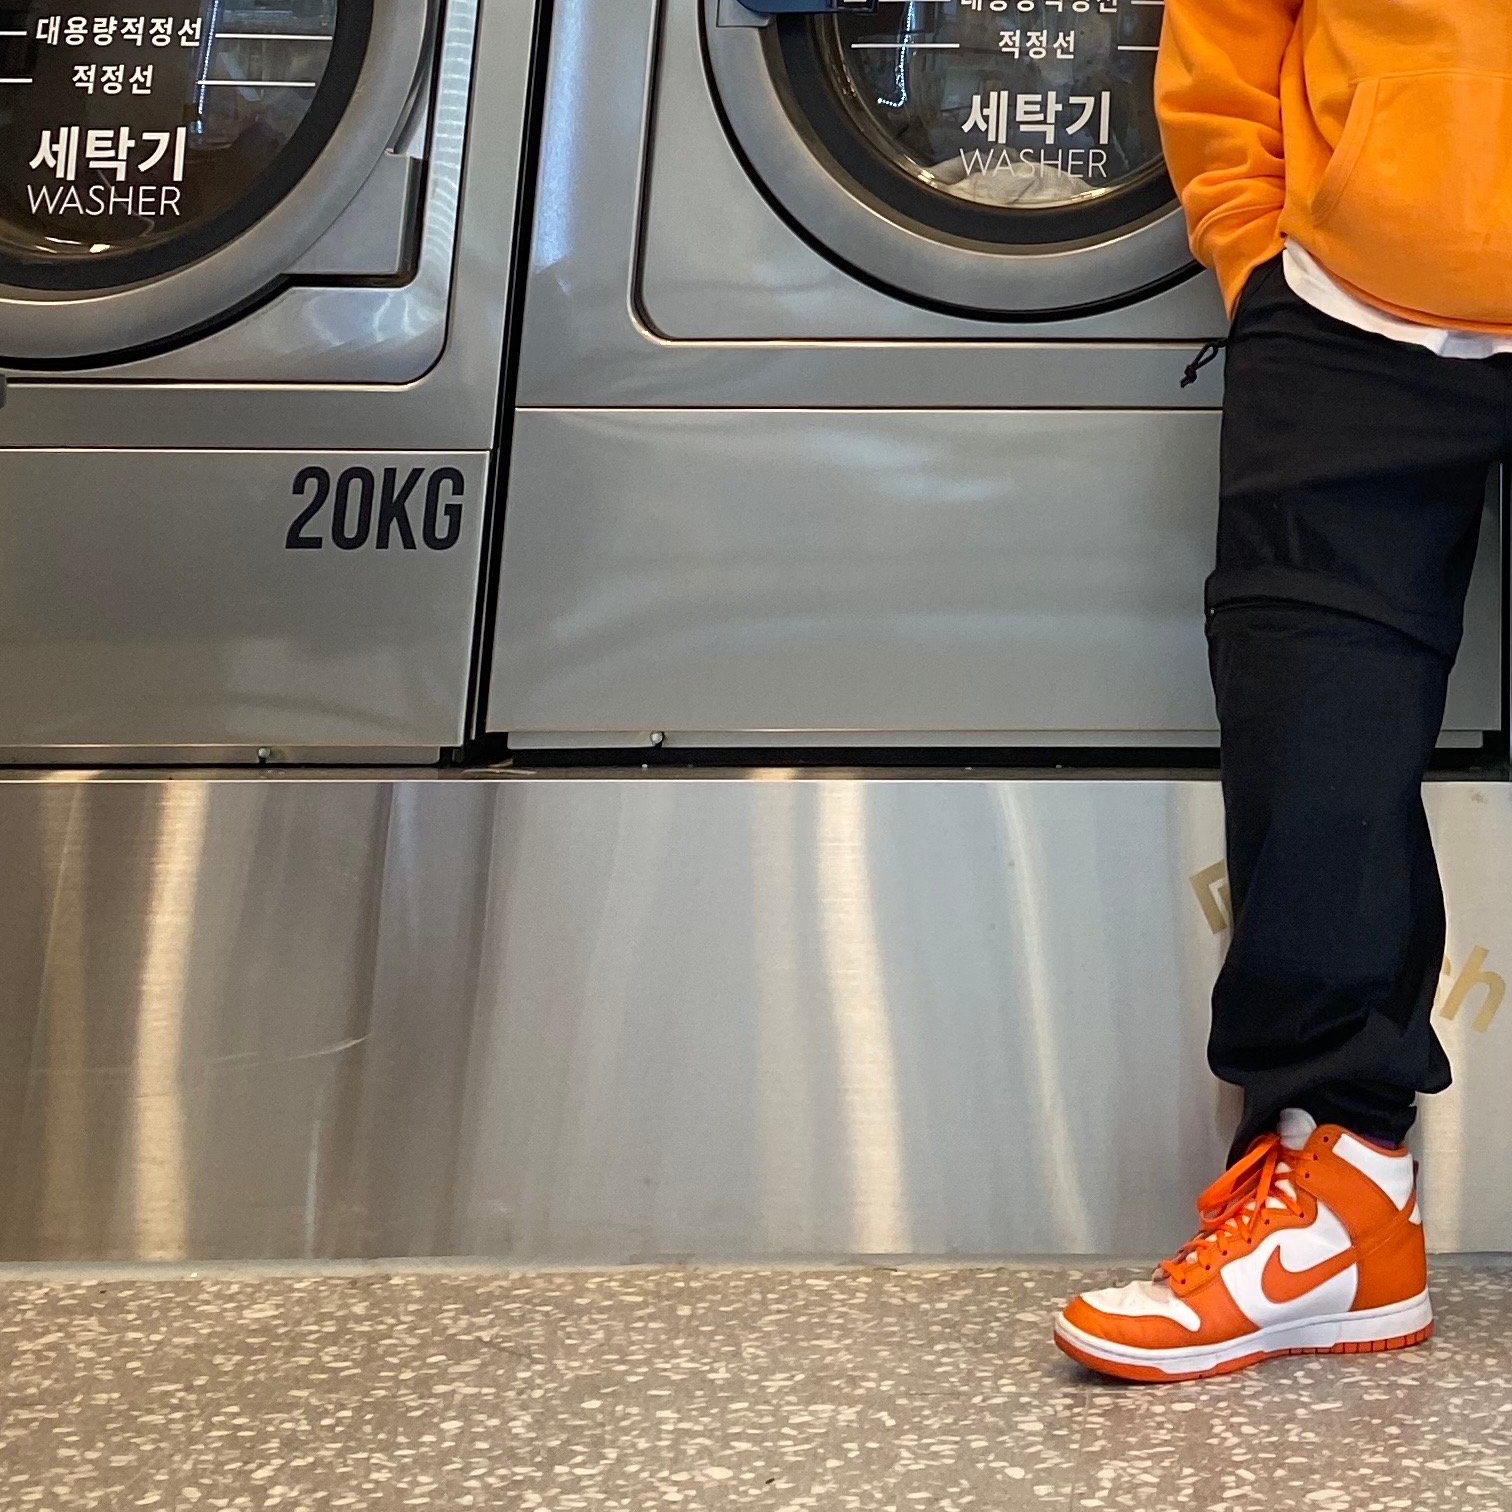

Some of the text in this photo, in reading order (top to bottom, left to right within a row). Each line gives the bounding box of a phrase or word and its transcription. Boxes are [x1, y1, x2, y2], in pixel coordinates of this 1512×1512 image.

[36, 16, 202, 47] 대용량적정선
[999, 31, 1076, 60] 적정선
[72, 65, 154, 95] 적정선
[961, 90, 1111, 145] 세탁기
[29, 126, 187, 182] 세탁기
[959, 149, 1107, 178] WASHER
[27, 184, 181, 217] WASHER
[285, 466, 465, 550] 20KG
